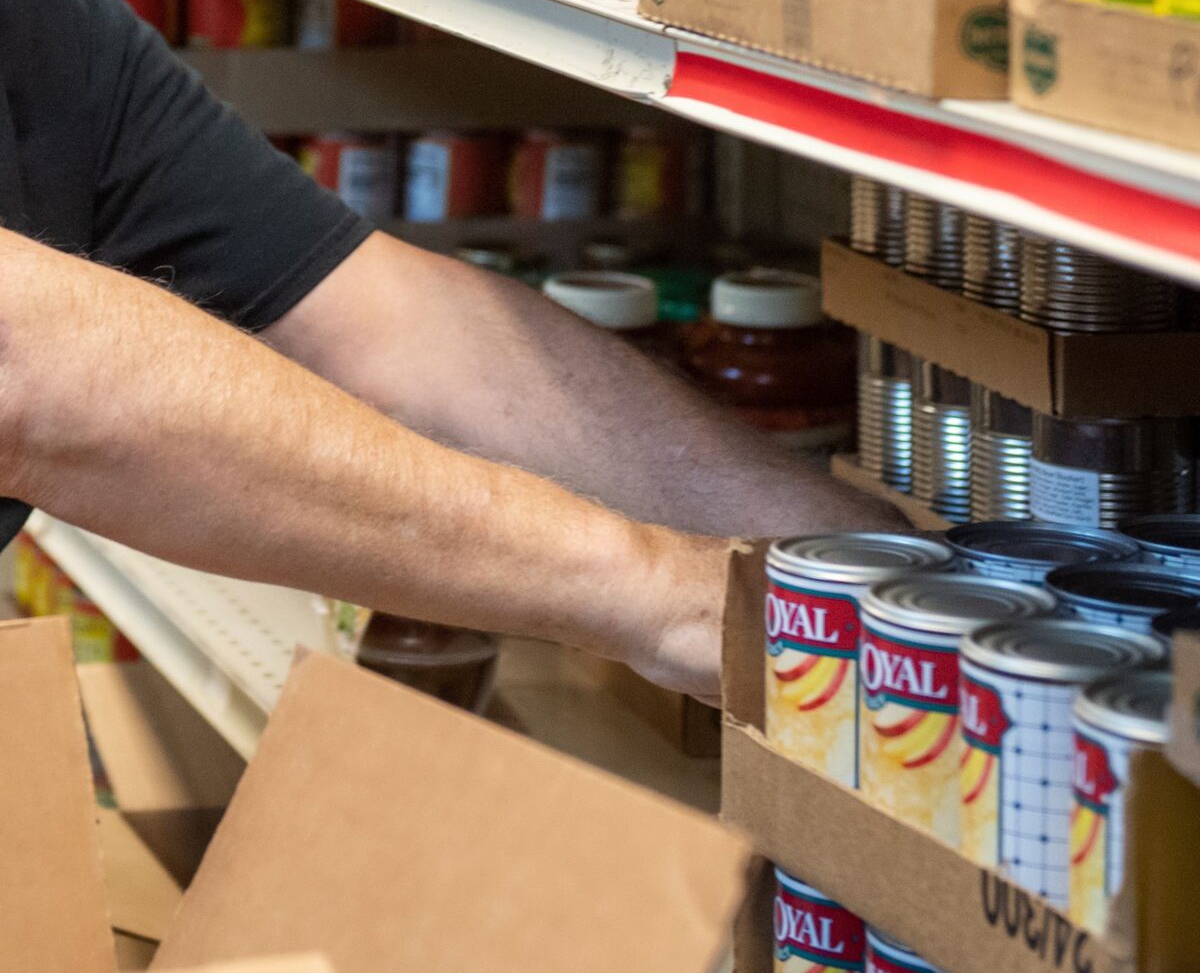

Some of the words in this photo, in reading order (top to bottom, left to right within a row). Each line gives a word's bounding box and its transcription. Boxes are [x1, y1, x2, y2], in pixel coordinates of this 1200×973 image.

[766, 592, 839, 644] OYAL
[861, 642, 950, 700] OYAL
[774, 895, 846, 955] OYAL
